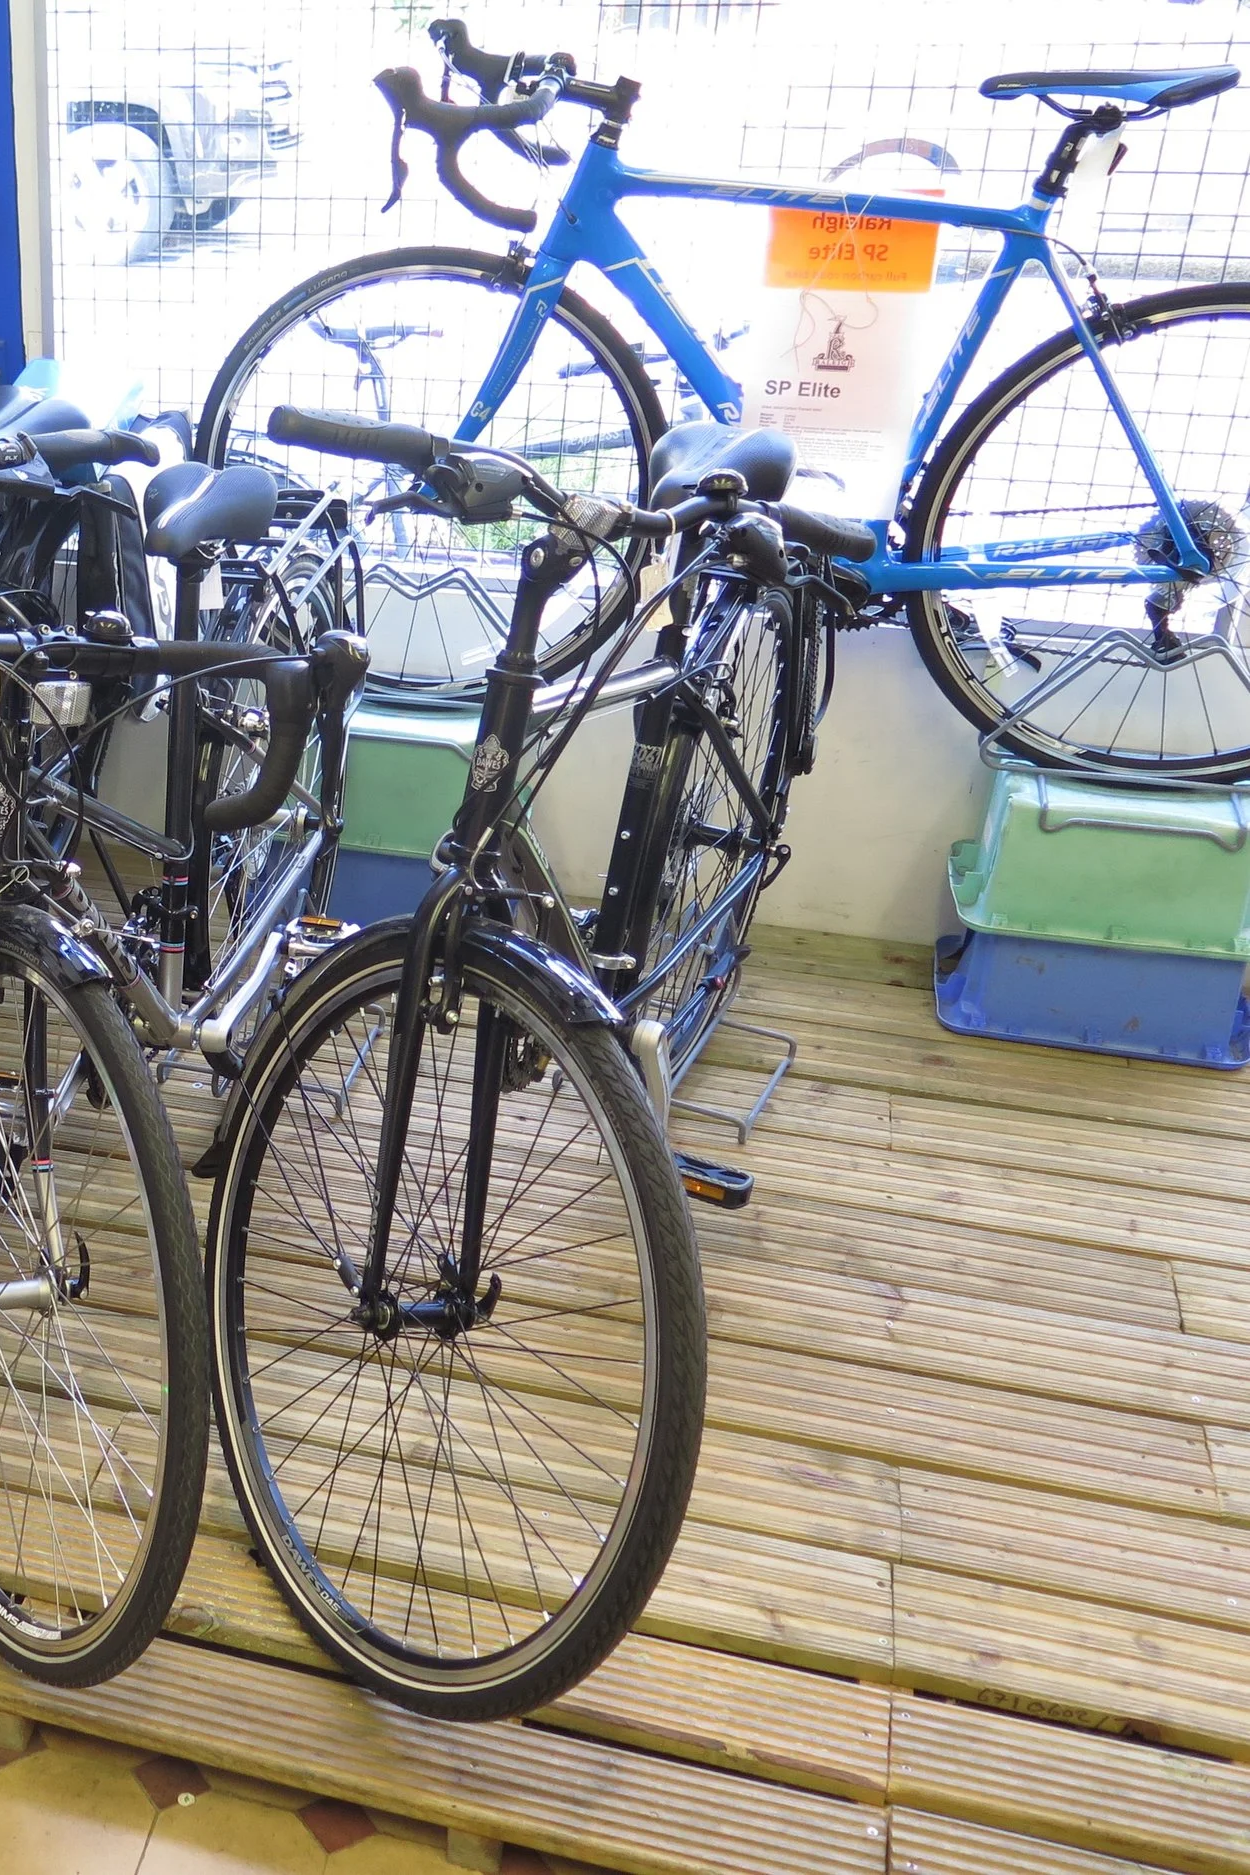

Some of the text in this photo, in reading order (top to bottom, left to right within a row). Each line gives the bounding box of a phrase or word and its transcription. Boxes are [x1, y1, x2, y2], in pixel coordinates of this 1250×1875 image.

[712, 185, 844, 205] ELITE
[765, 379, 842, 399] SP Elite
[1004, 567, 1137, 581] ELITE
[476, 756, 502, 770] DAWES
[281, 1533, 324, 1593] DAWES
